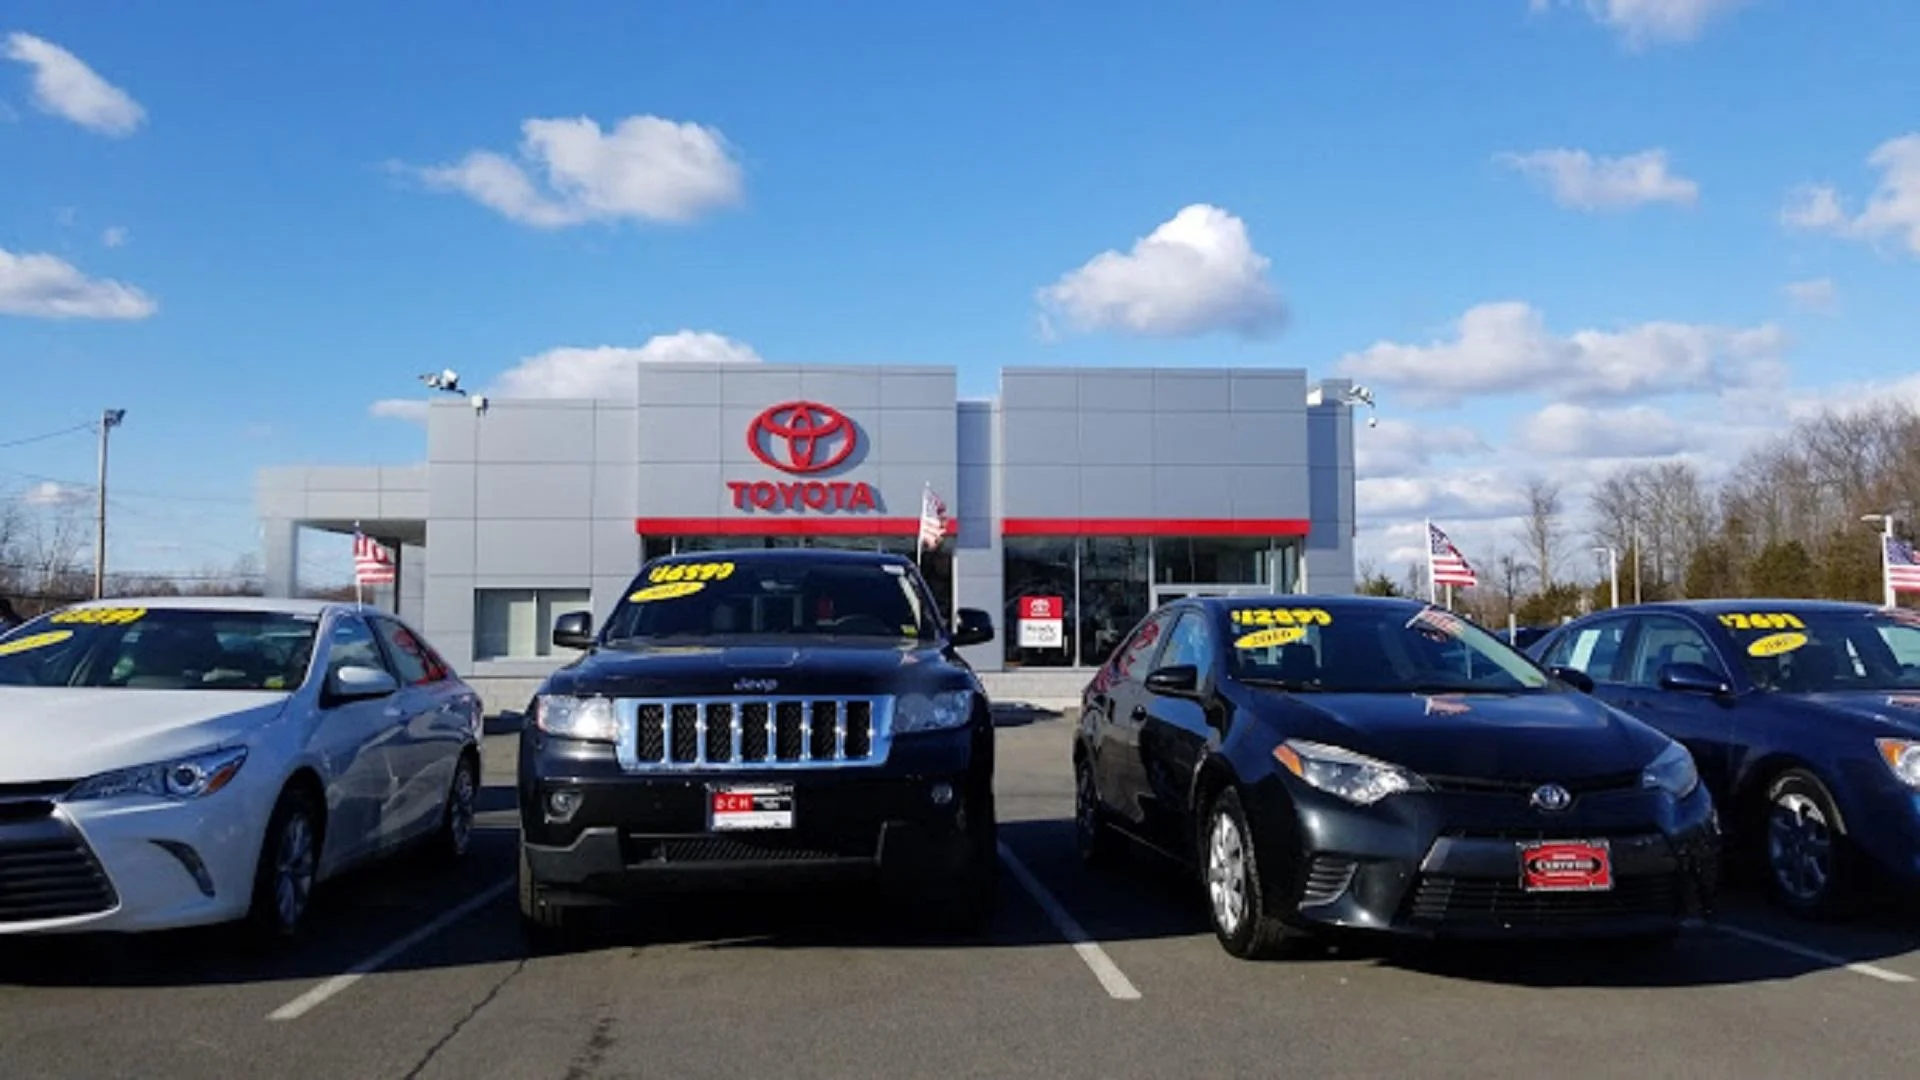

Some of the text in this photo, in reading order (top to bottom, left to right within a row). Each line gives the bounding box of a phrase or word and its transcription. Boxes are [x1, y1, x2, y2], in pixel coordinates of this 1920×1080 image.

[727, 481, 876, 510] TOYOTA
[733, 676, 777, 693] Jeep
[715, 796, 750, 810] DCH
